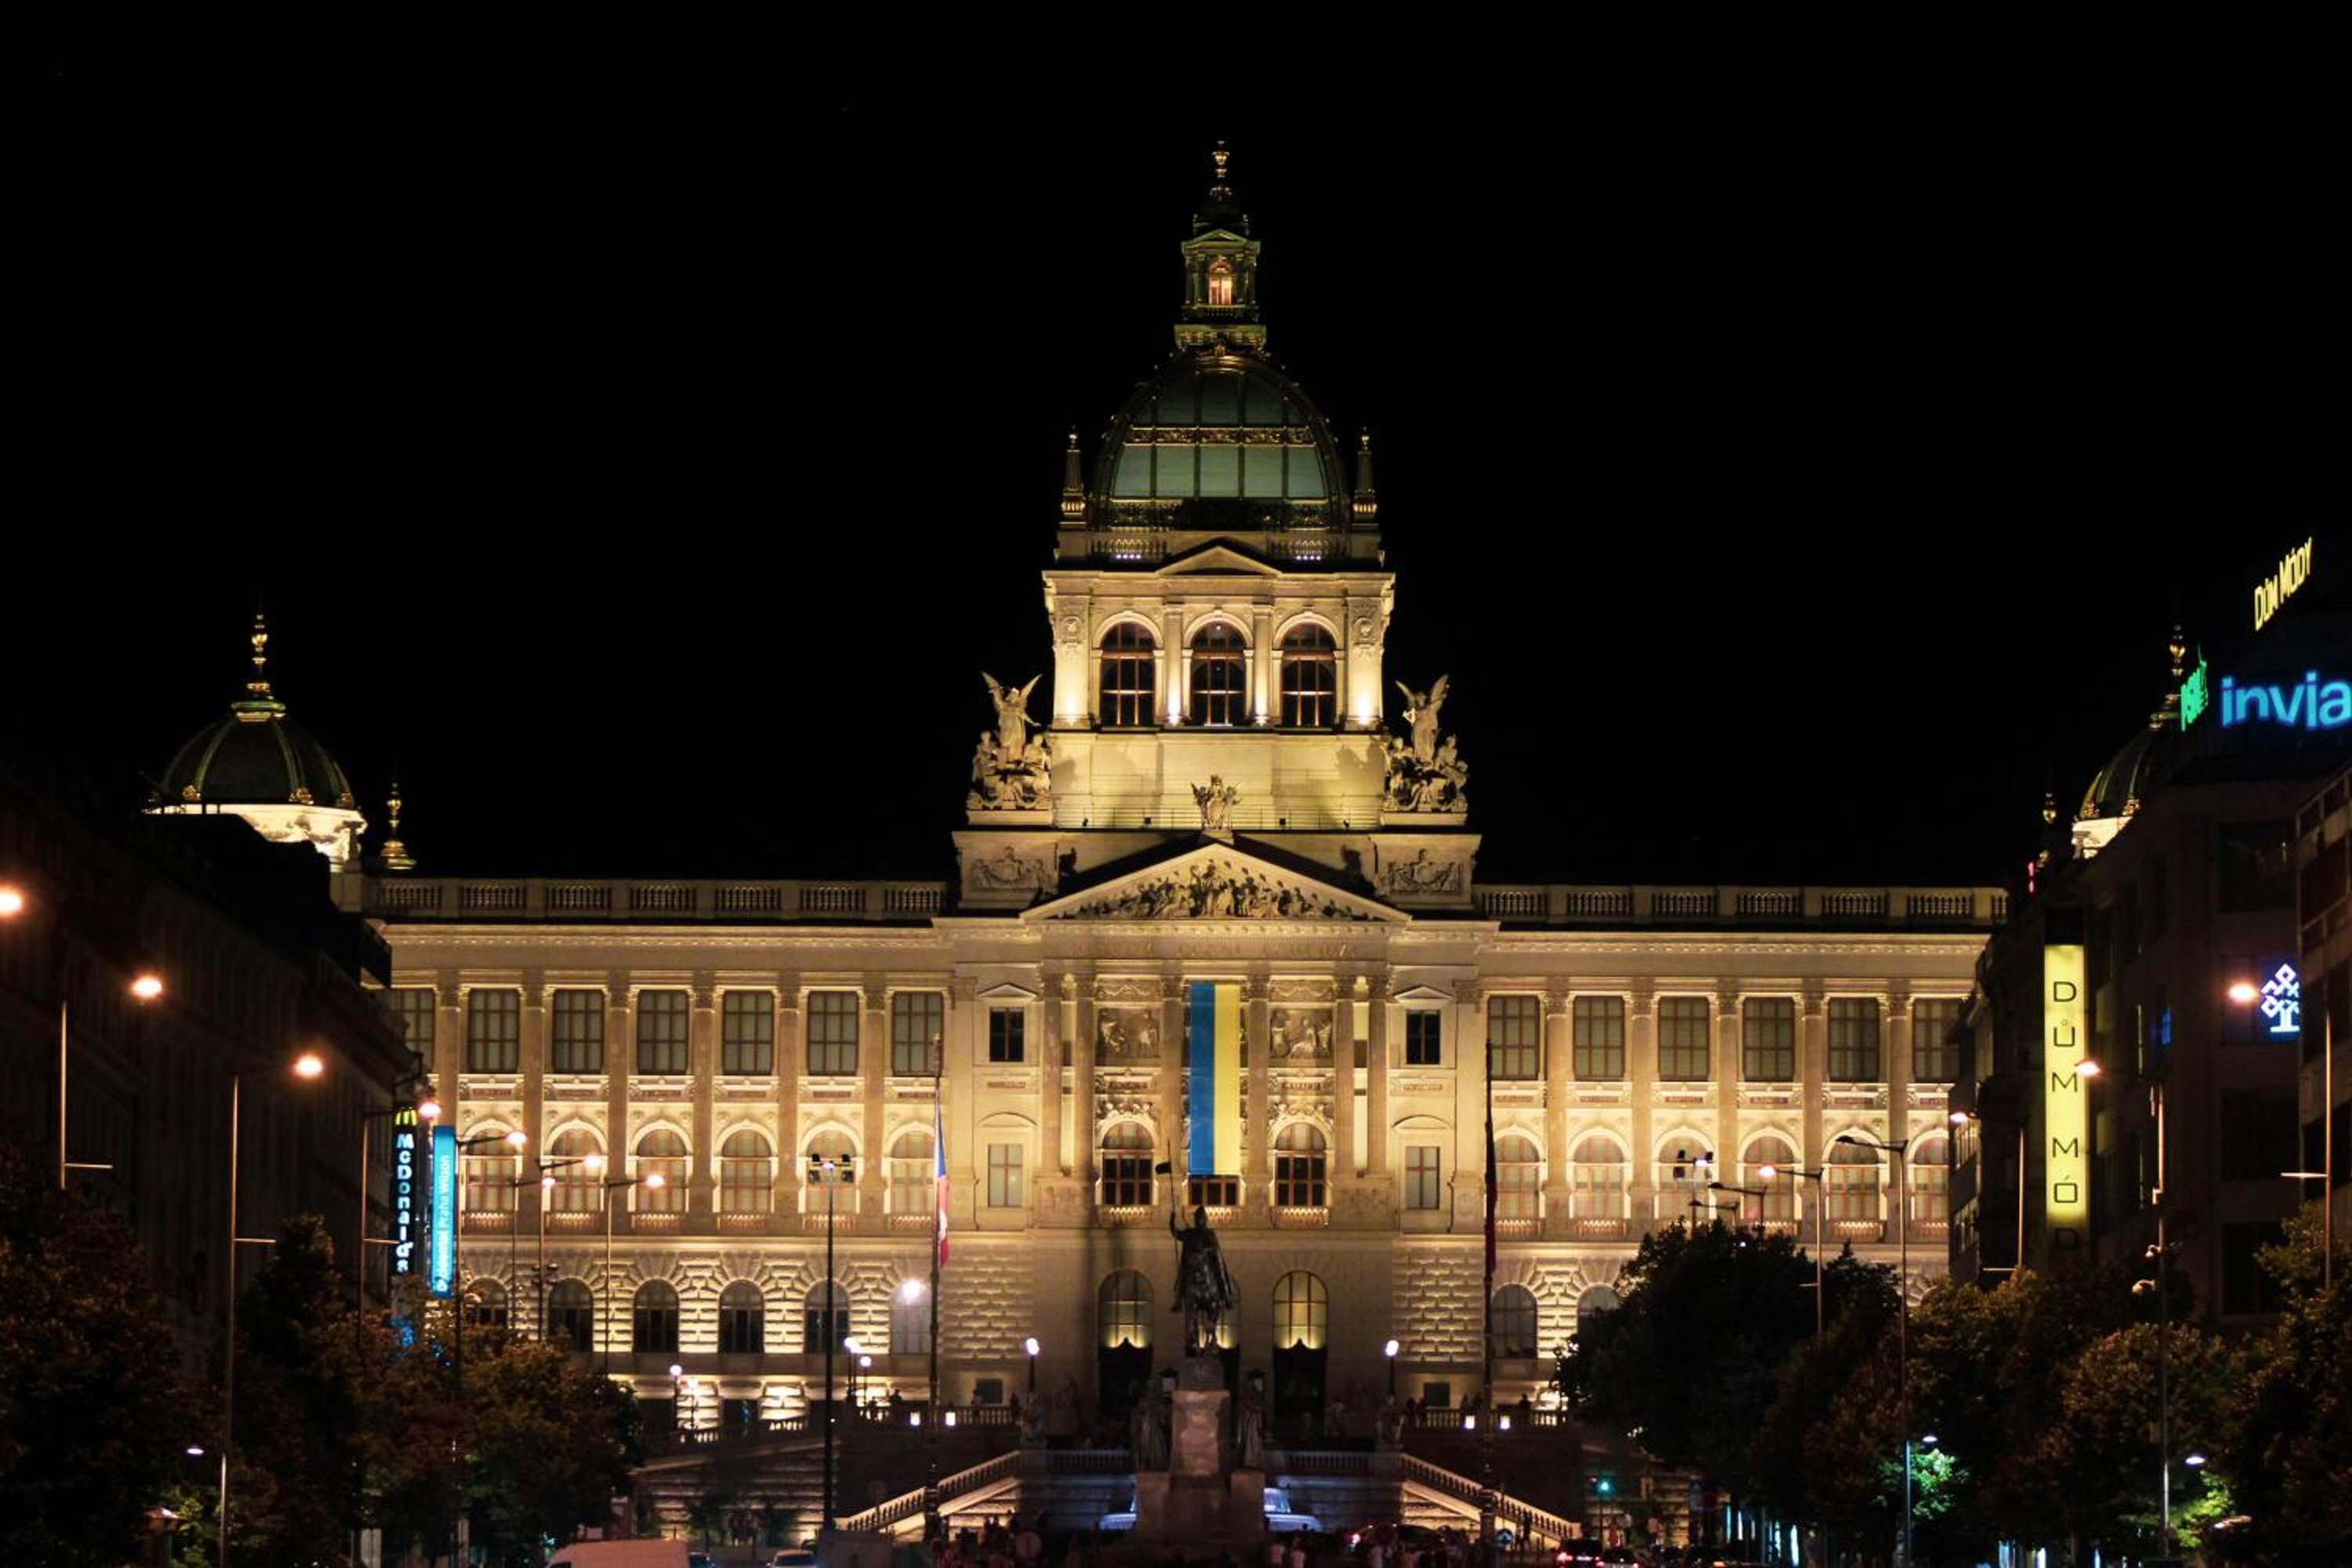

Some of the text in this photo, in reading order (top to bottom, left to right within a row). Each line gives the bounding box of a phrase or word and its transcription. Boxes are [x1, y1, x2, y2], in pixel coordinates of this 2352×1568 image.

[2220, 670, 2352, 729] invia
[2052, 982, 2078, 1092] DŮM
[438, 1196, 450, 1229] Praha
